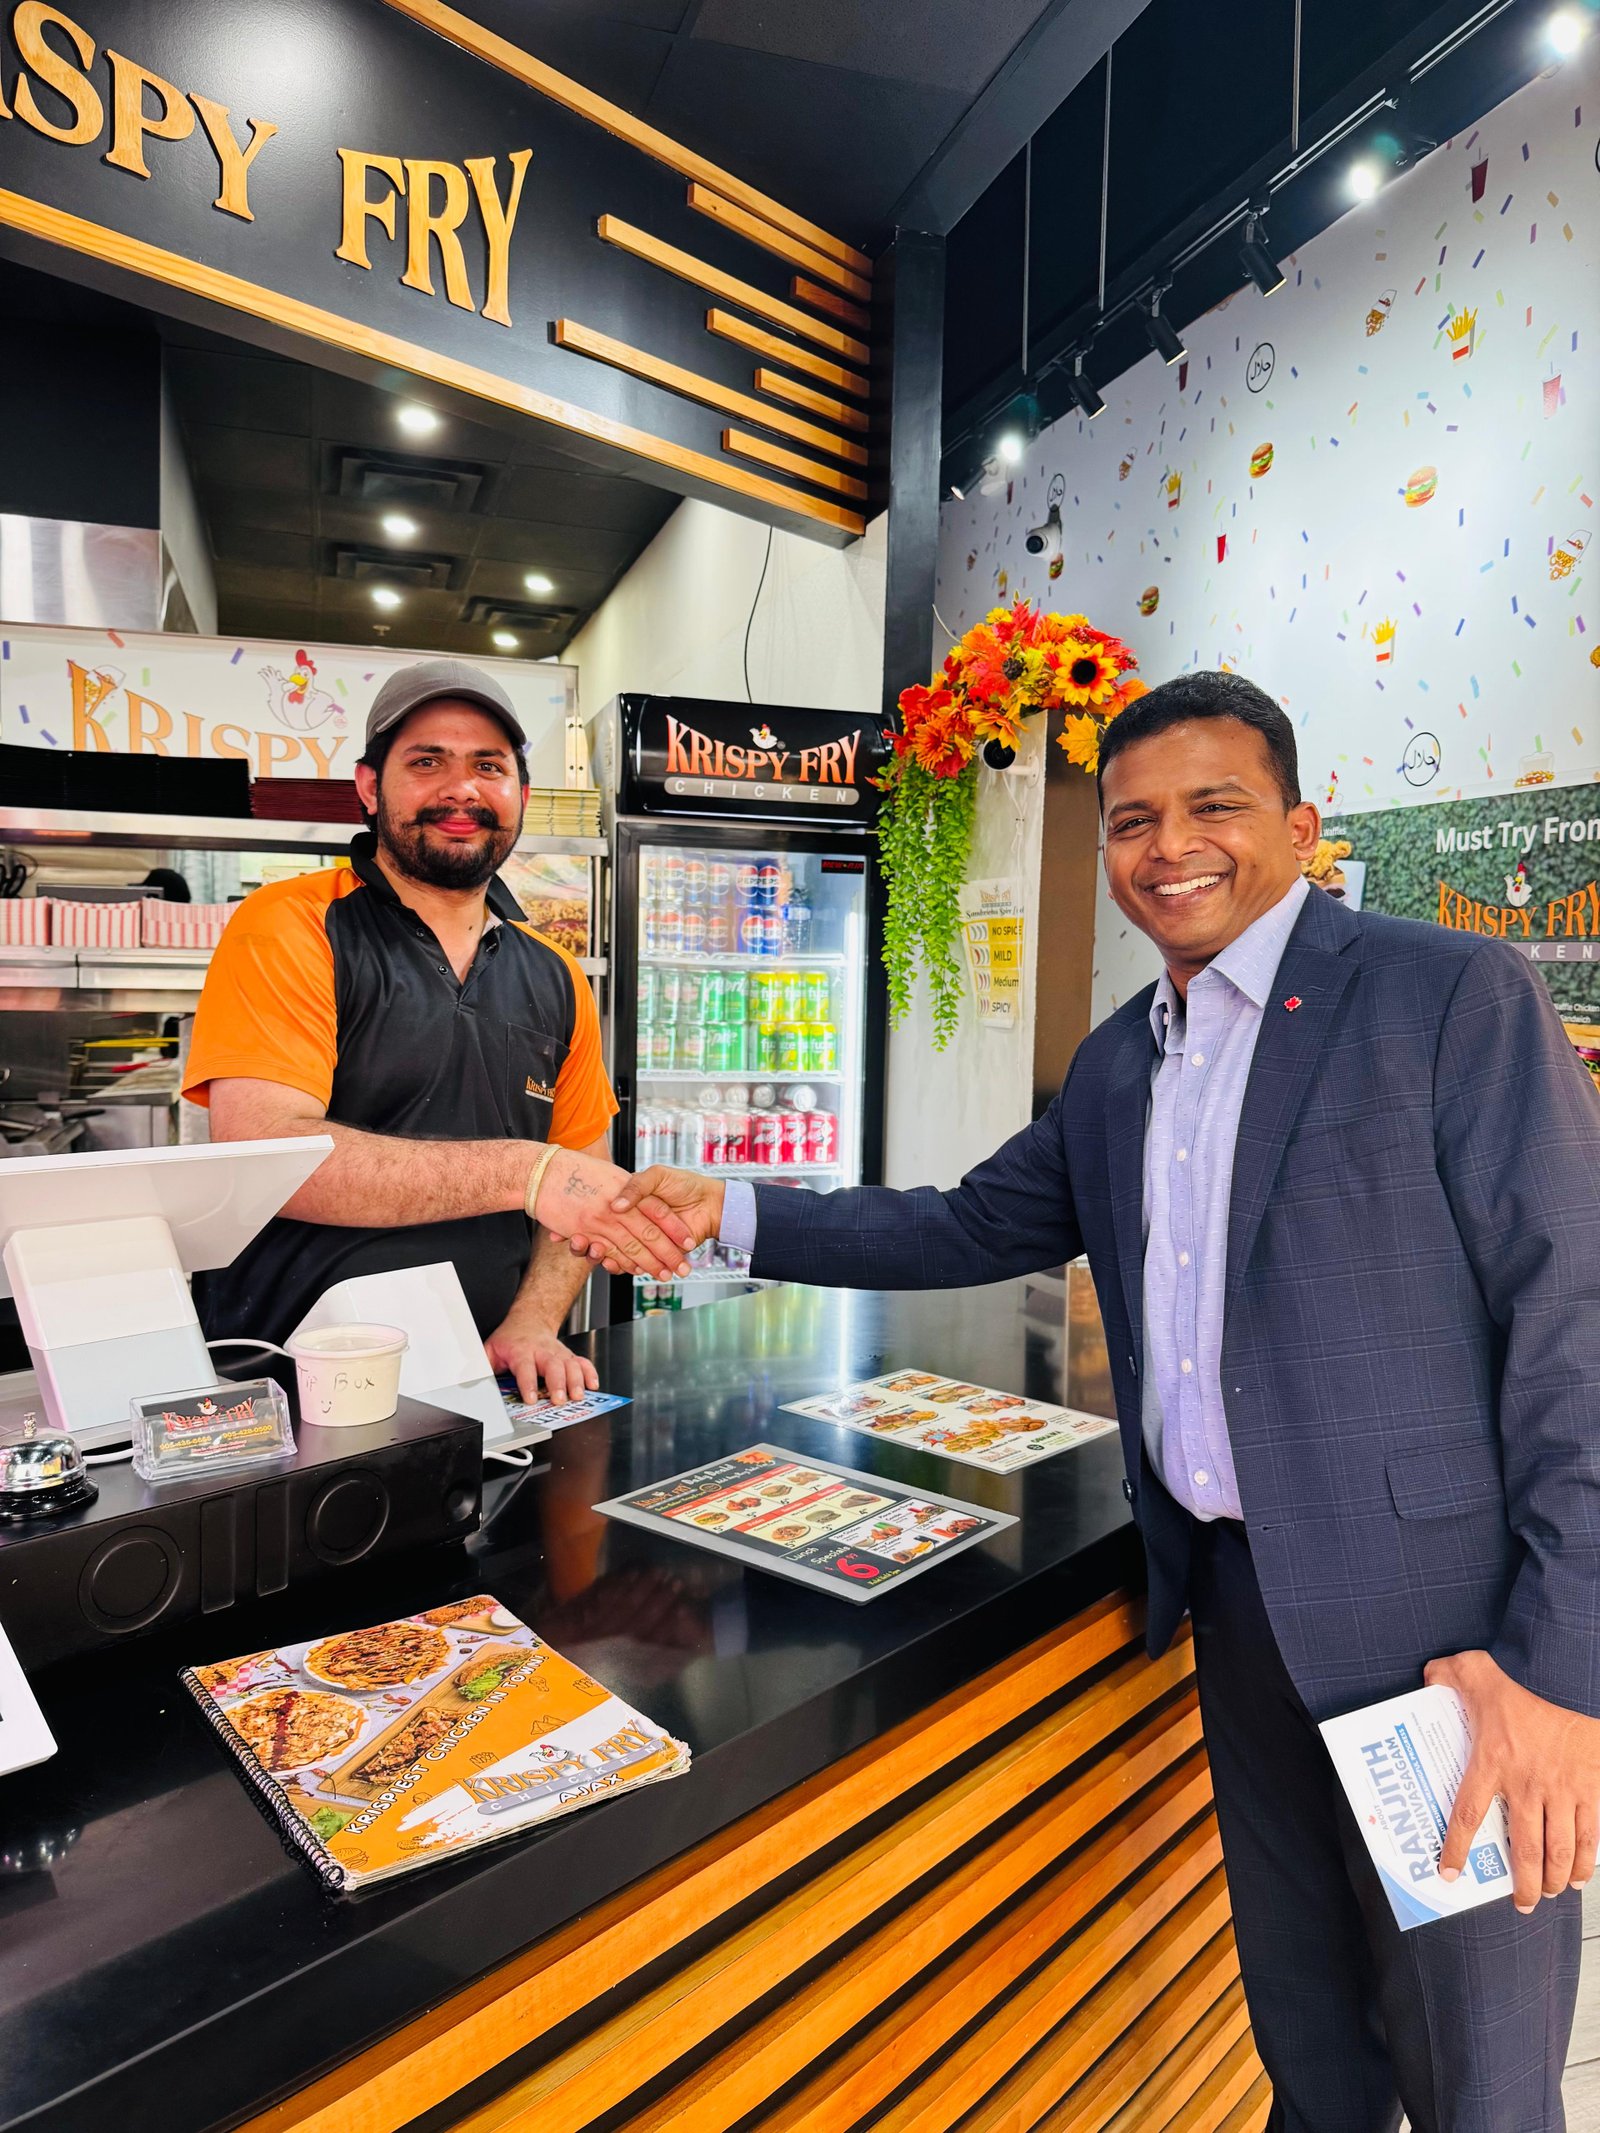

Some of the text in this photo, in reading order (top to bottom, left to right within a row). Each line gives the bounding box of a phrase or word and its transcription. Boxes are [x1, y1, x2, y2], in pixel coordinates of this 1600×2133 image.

[0, 0, 533, 327] SPY FRY
[665, 714, 861, 784] KRISPY FRY
[675, 780, 846, 803] CHICKEN
[1436, 827, 1493, 853] Must
[1498, 820, 1537, 854] Try
[1438, 880, 1537, 937] KRISPY
[992, 925, 1022, 936] NO SPICE
[993, 950, 1012, 961] MILD
[993, 976, 1019, 988] Medium
[992, 1002, 1012, 1013] SPICY
[786, 1546, 819, 1561] Lunch
[811, 1545, 851, 1565] Specials
[345, 1653, 550, 1836] KRISPIEST CHICKEN IN TOWN!
[1398, 1727, 1417, 1761] PROGRESS
[455, 1718, 652, 1804] KRISPY FRY
[558, 1773, 626, 1804] AJAX
[1360, 1740, 1434, 1882] RANJITH
[1374, 1804, 1388, 1831] ABOUT
